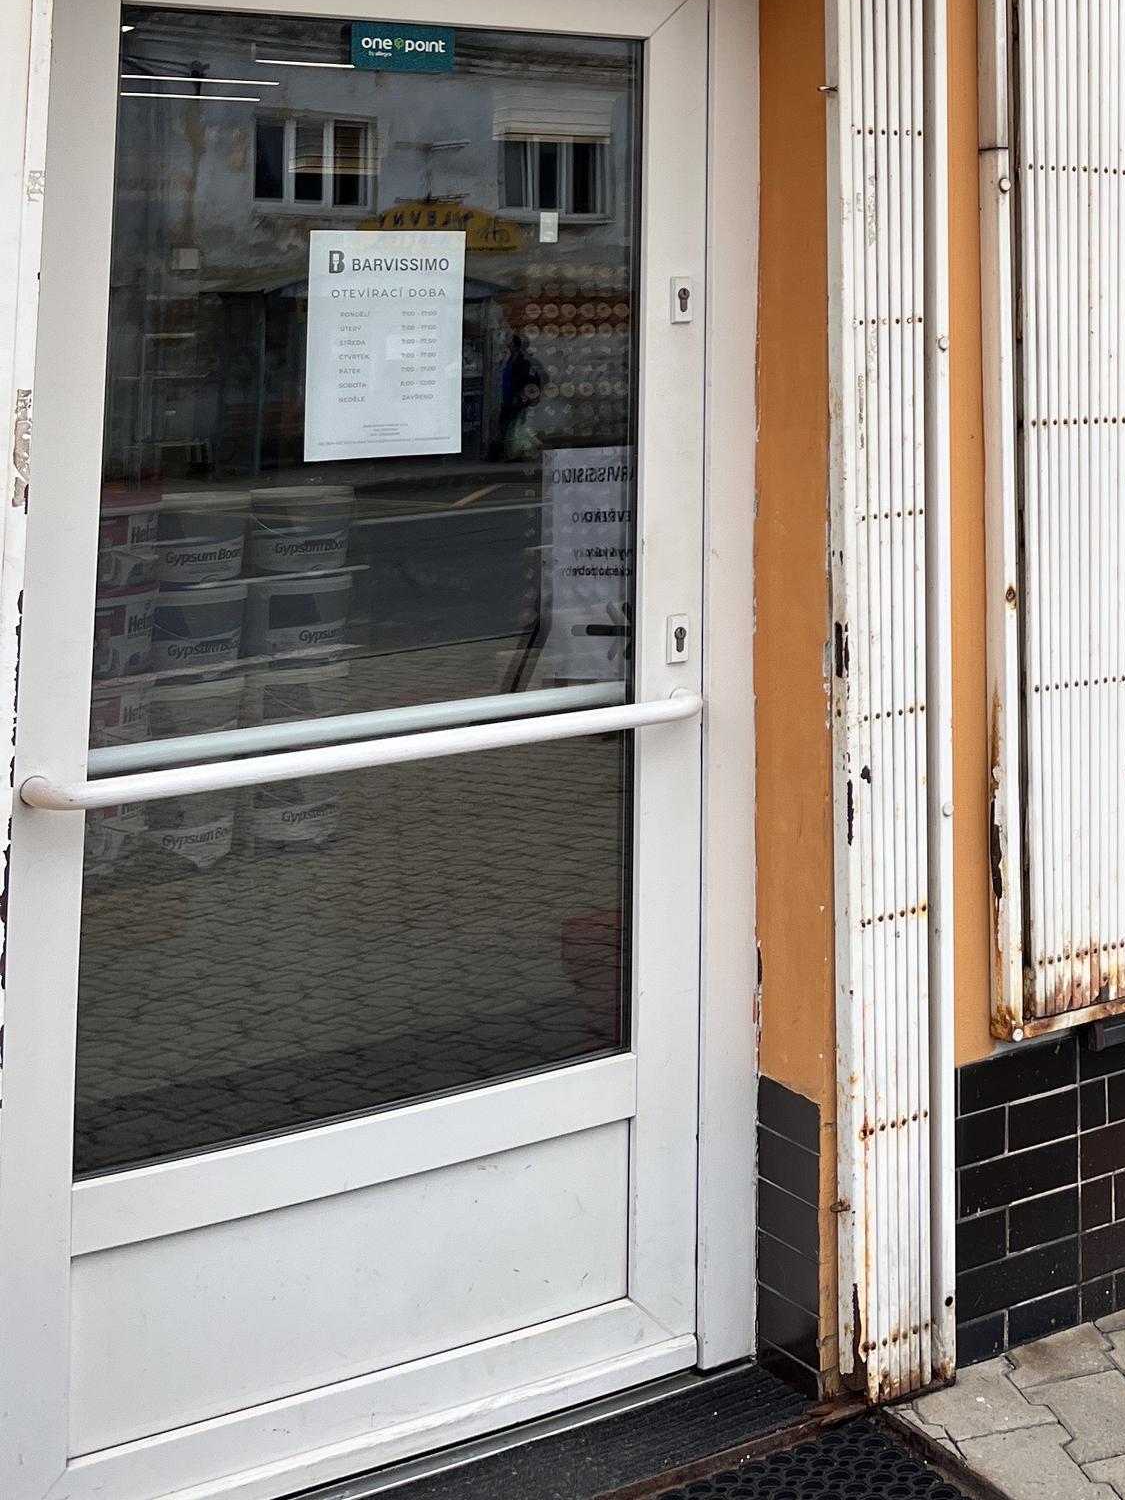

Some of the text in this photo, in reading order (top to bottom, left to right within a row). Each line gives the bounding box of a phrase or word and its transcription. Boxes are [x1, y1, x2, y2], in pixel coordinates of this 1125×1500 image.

[361, 37, 446, 53] one point
[352, 257, 450, 273] BARVISSIMO
[331, 286, 446, 299] OTEVÍRACÍ DOBA
[165, 551, 217, 566] Gypsum
